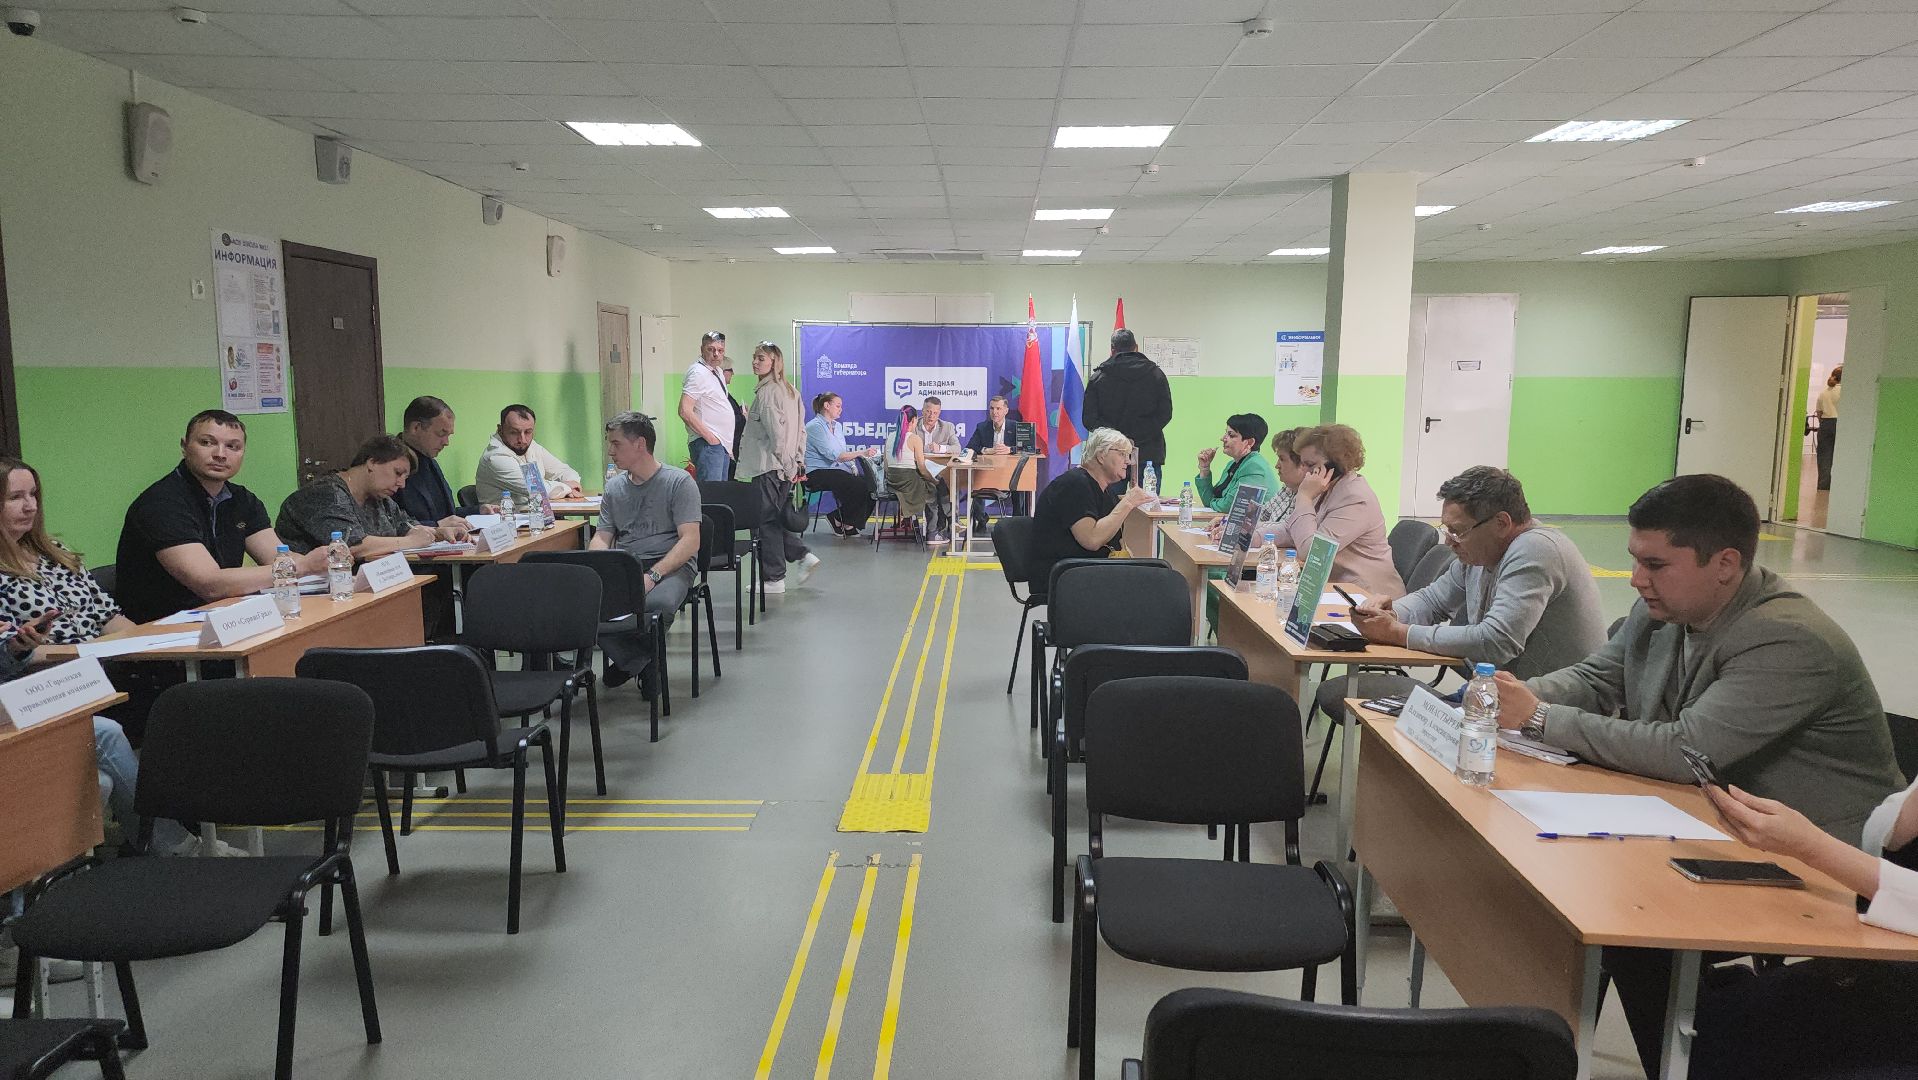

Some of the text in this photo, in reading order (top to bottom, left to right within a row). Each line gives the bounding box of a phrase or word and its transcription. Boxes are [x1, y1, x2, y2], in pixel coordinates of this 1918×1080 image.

[214, 249, 277, 270] ИНФОРМАЦИЯ
[918, 389, 978, 397] АДМИНИСТРАЦИЯ
[222, 620, 237, 631] ООО
[24, 683, 45, 696] ООО
[18, 691, 67, 716] управляющая
